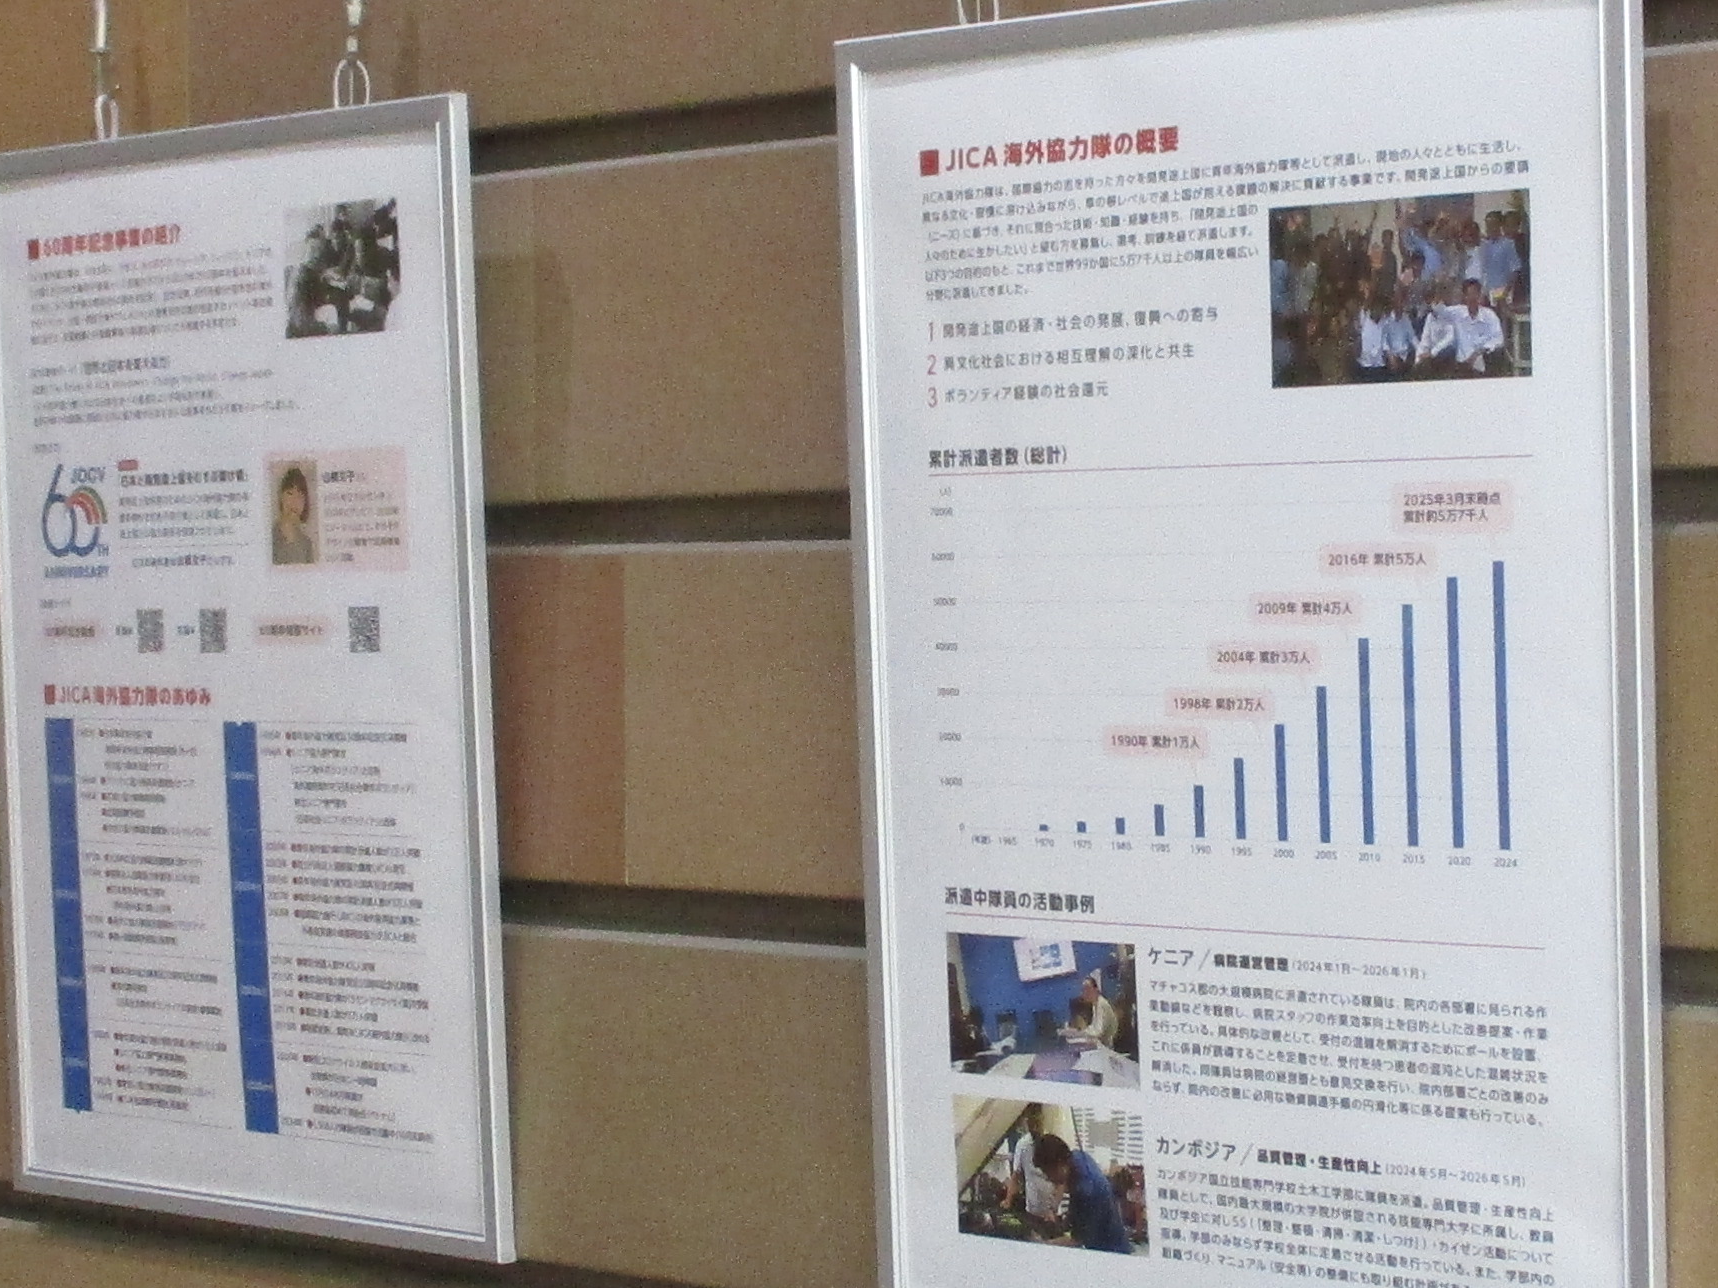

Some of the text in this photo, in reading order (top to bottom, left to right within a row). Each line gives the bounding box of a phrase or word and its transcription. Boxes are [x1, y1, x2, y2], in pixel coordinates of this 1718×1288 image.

[944, 124, 1180, 171] JICA 海外協力隊の概要
[926, 321, 934, 342] 1
[925, 353, 936, 376] 2
[927, 386, 938, 408] 3
[1327, 551, 1369, 567] 2016年
[1257, 601, 1297, 615] 2009年
[1216, 650, 1255, 664] 2004年
[1173, 696, 1212, 711] 1998年
[1109, 732, 1149, 749] 1990年
[1493, 858, 1517, 870] 2024
[944, 885, 1095, 914] 派遣中隊員の活動事例
